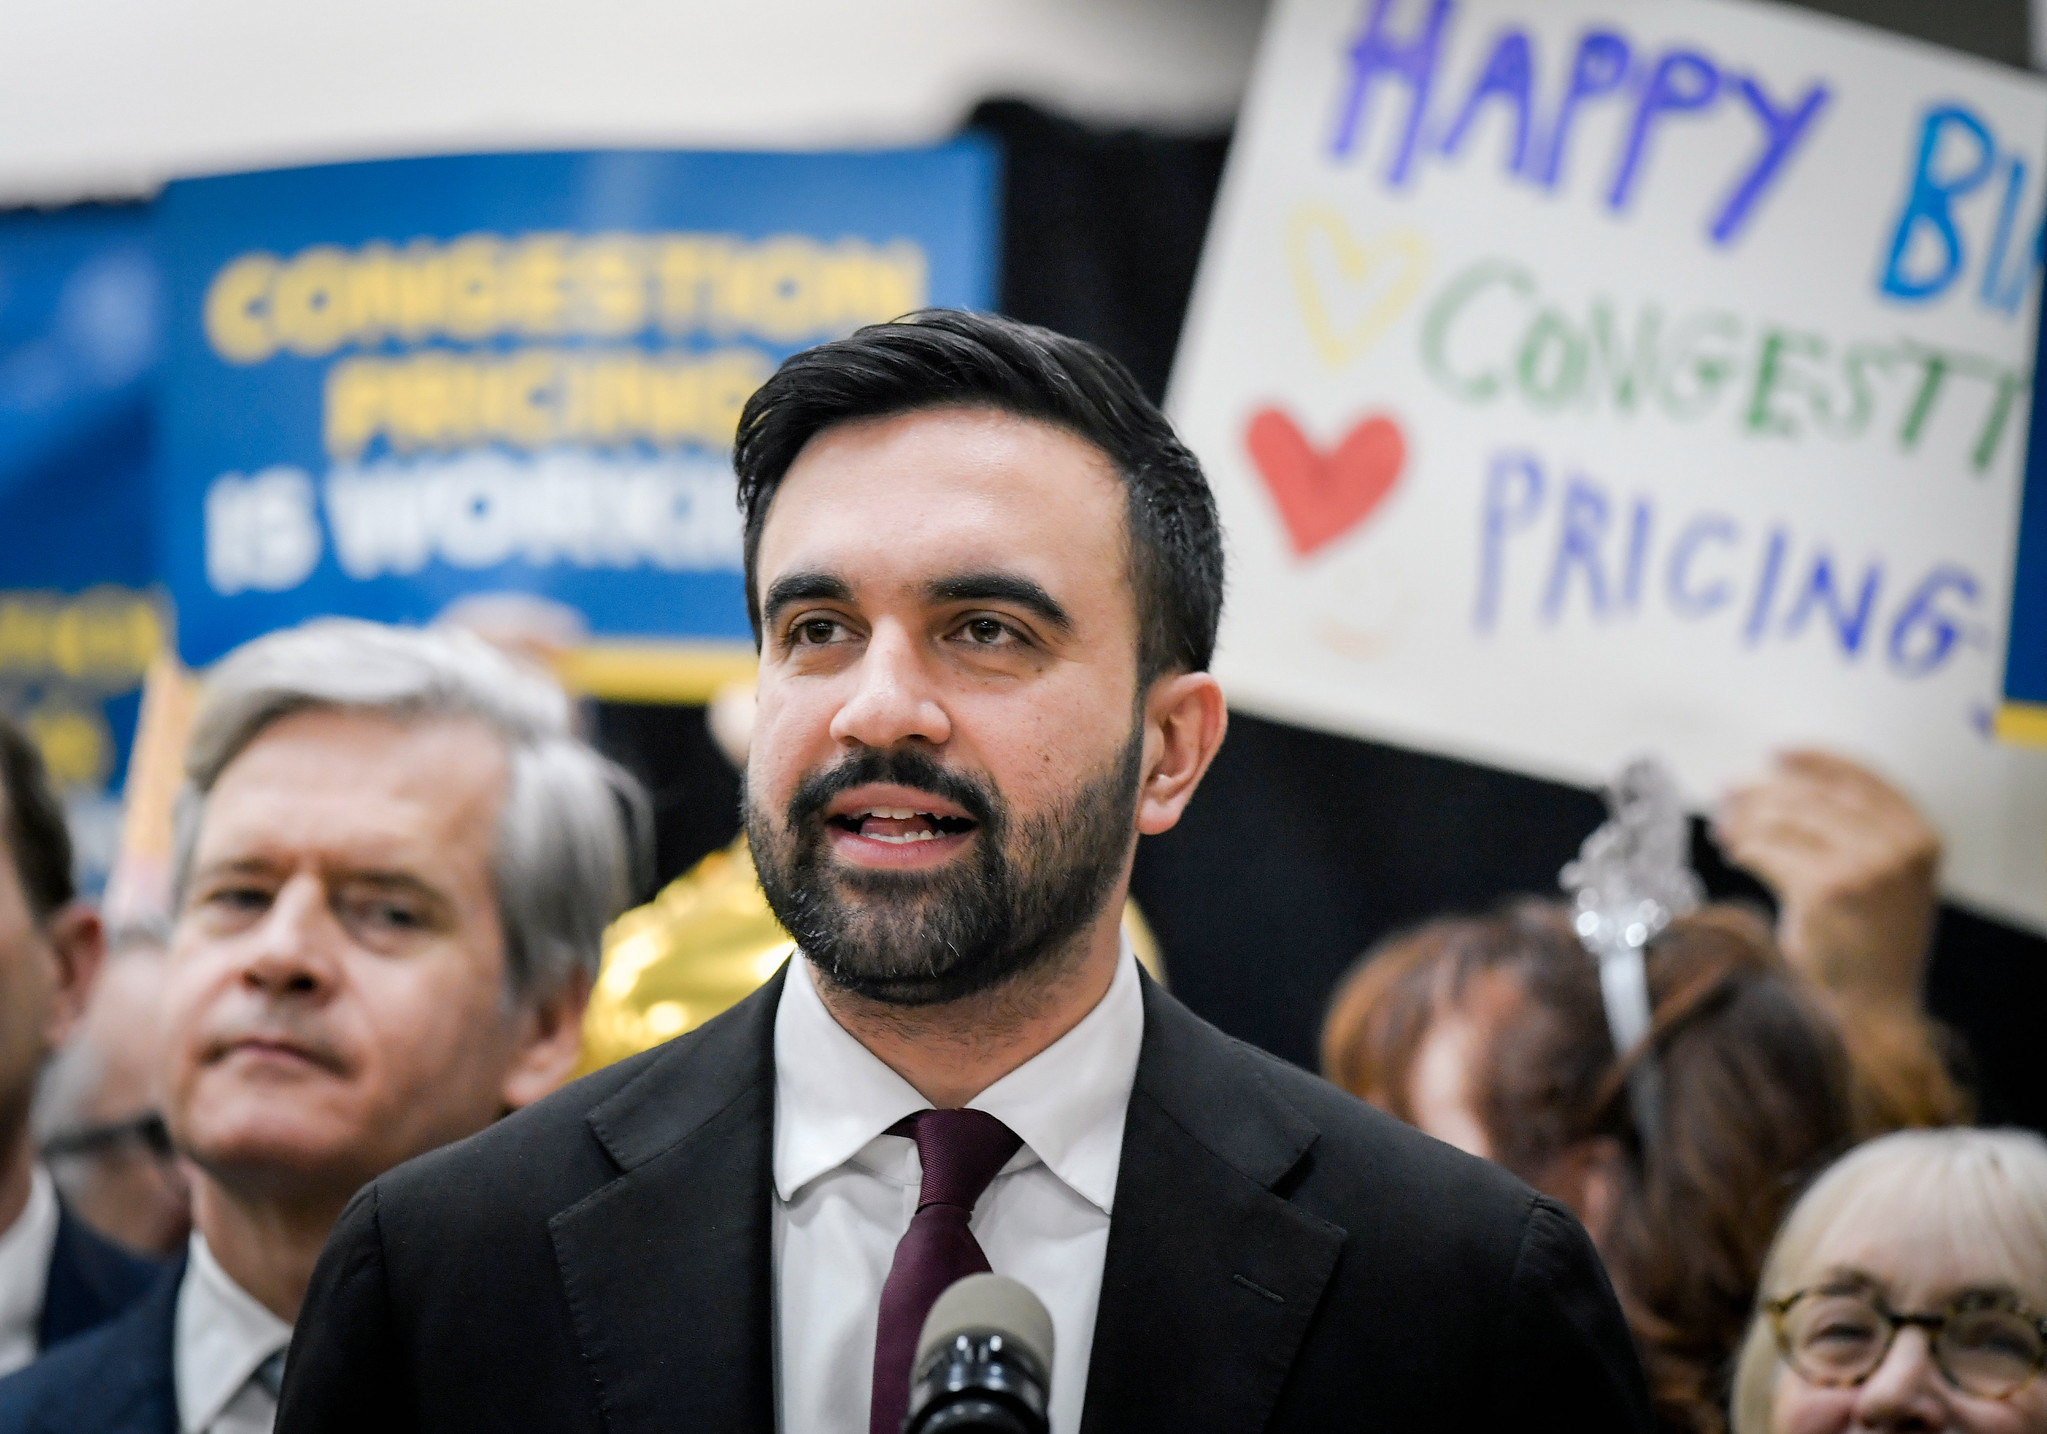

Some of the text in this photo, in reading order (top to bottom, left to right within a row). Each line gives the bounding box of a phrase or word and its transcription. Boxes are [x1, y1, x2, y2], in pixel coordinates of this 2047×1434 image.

[1327, 0, 1832, 247] HAPPY
[206, 232, 928, 364] CONGESTION
[206, 466, 322, 595] IS
[1474, 452, 1988, 680] PRICING
